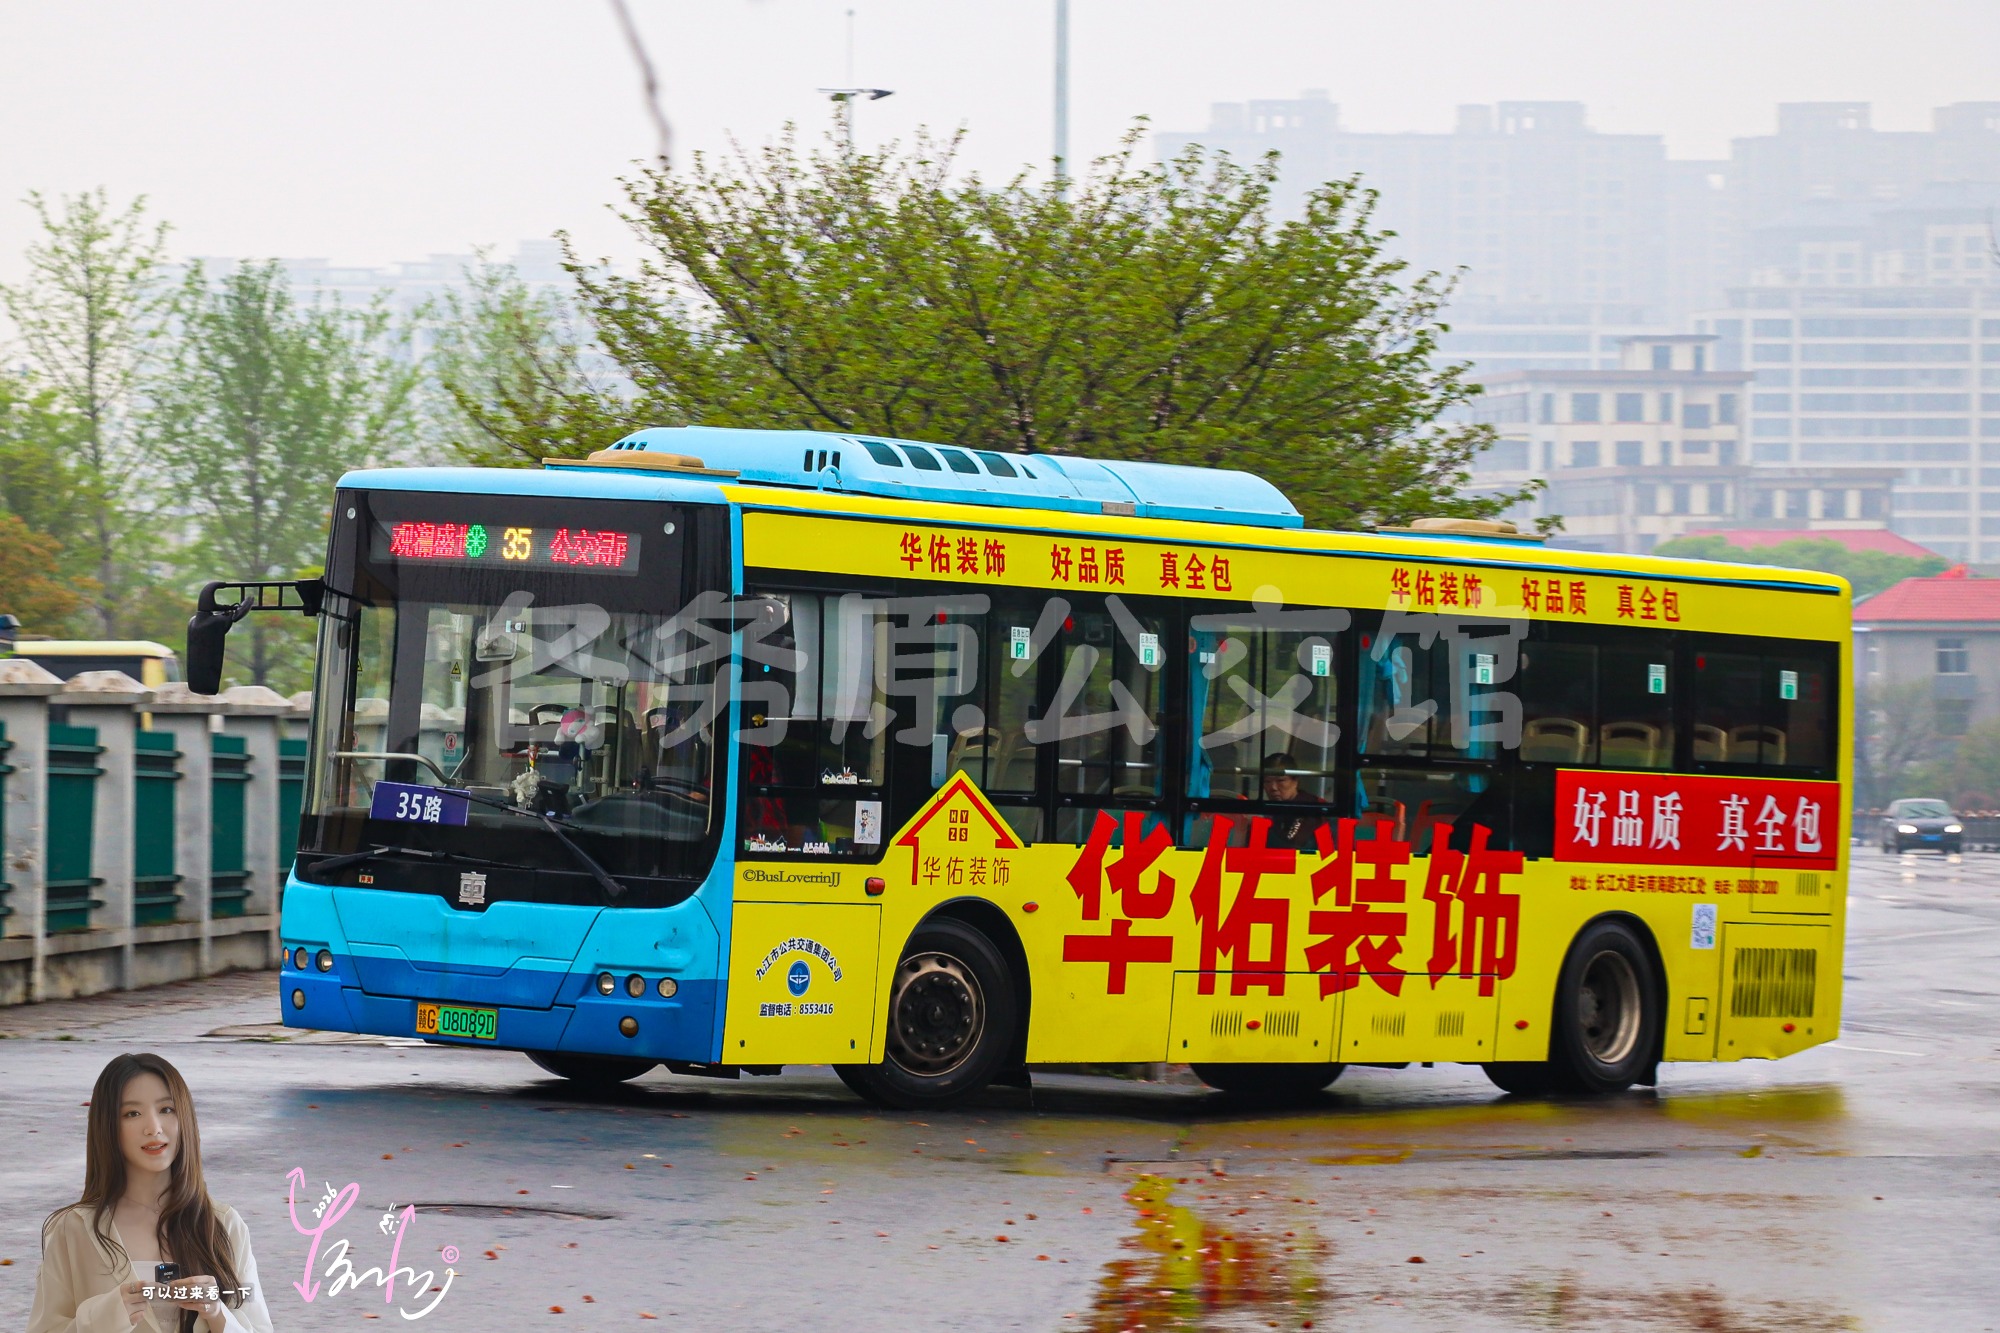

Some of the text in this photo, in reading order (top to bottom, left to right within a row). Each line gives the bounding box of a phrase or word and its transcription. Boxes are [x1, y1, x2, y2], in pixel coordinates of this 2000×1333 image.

[502, 527, 533, 560] 35
[899, 531, 1232, 592] 华佑装饰 好品质 真全包
[1391, 567, 1681, 623] 华佑装饰 好品质 真全包
[395, 791, 442, 823] 35路
[1573, 786, 1822, 852] 好品质 真全包
[923, 856, 1010, 886] 华佑装饰
[1062, 809, 1524, 1001] 华佑装饰
[755, 937, 843, 982] 九江市公共交通集团公司
